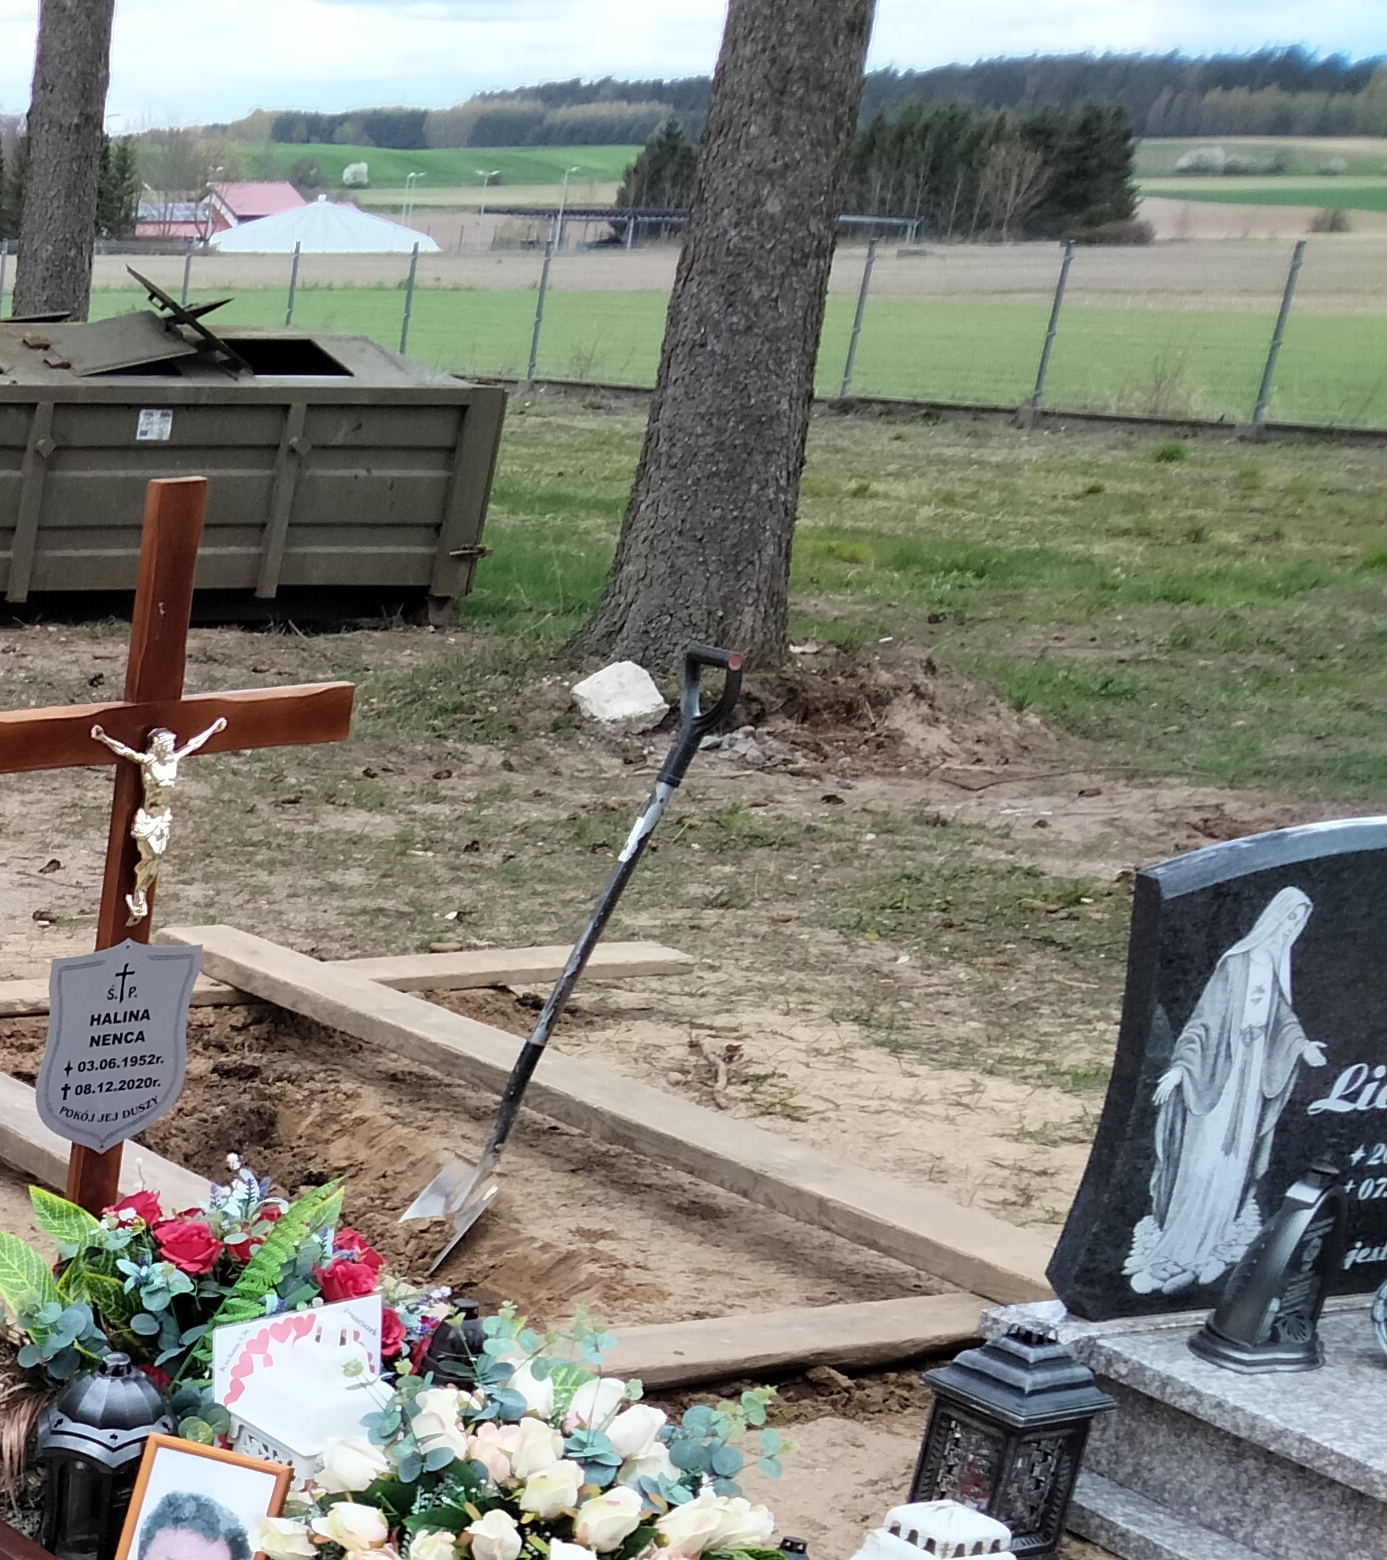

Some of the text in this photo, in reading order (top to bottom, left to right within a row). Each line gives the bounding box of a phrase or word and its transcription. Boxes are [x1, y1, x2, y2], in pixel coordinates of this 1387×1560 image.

[89, 1008, 151, 1027] HALINA
[89, 1030, 146, 1048] NENCA
[77, 1053, 165, 1073] 03.06.1952r.
[74, 1076, 162, 1096] 08.12.2020r.
[59, 1095, 159, 1123] POKÓJ JEJ DUSZY
